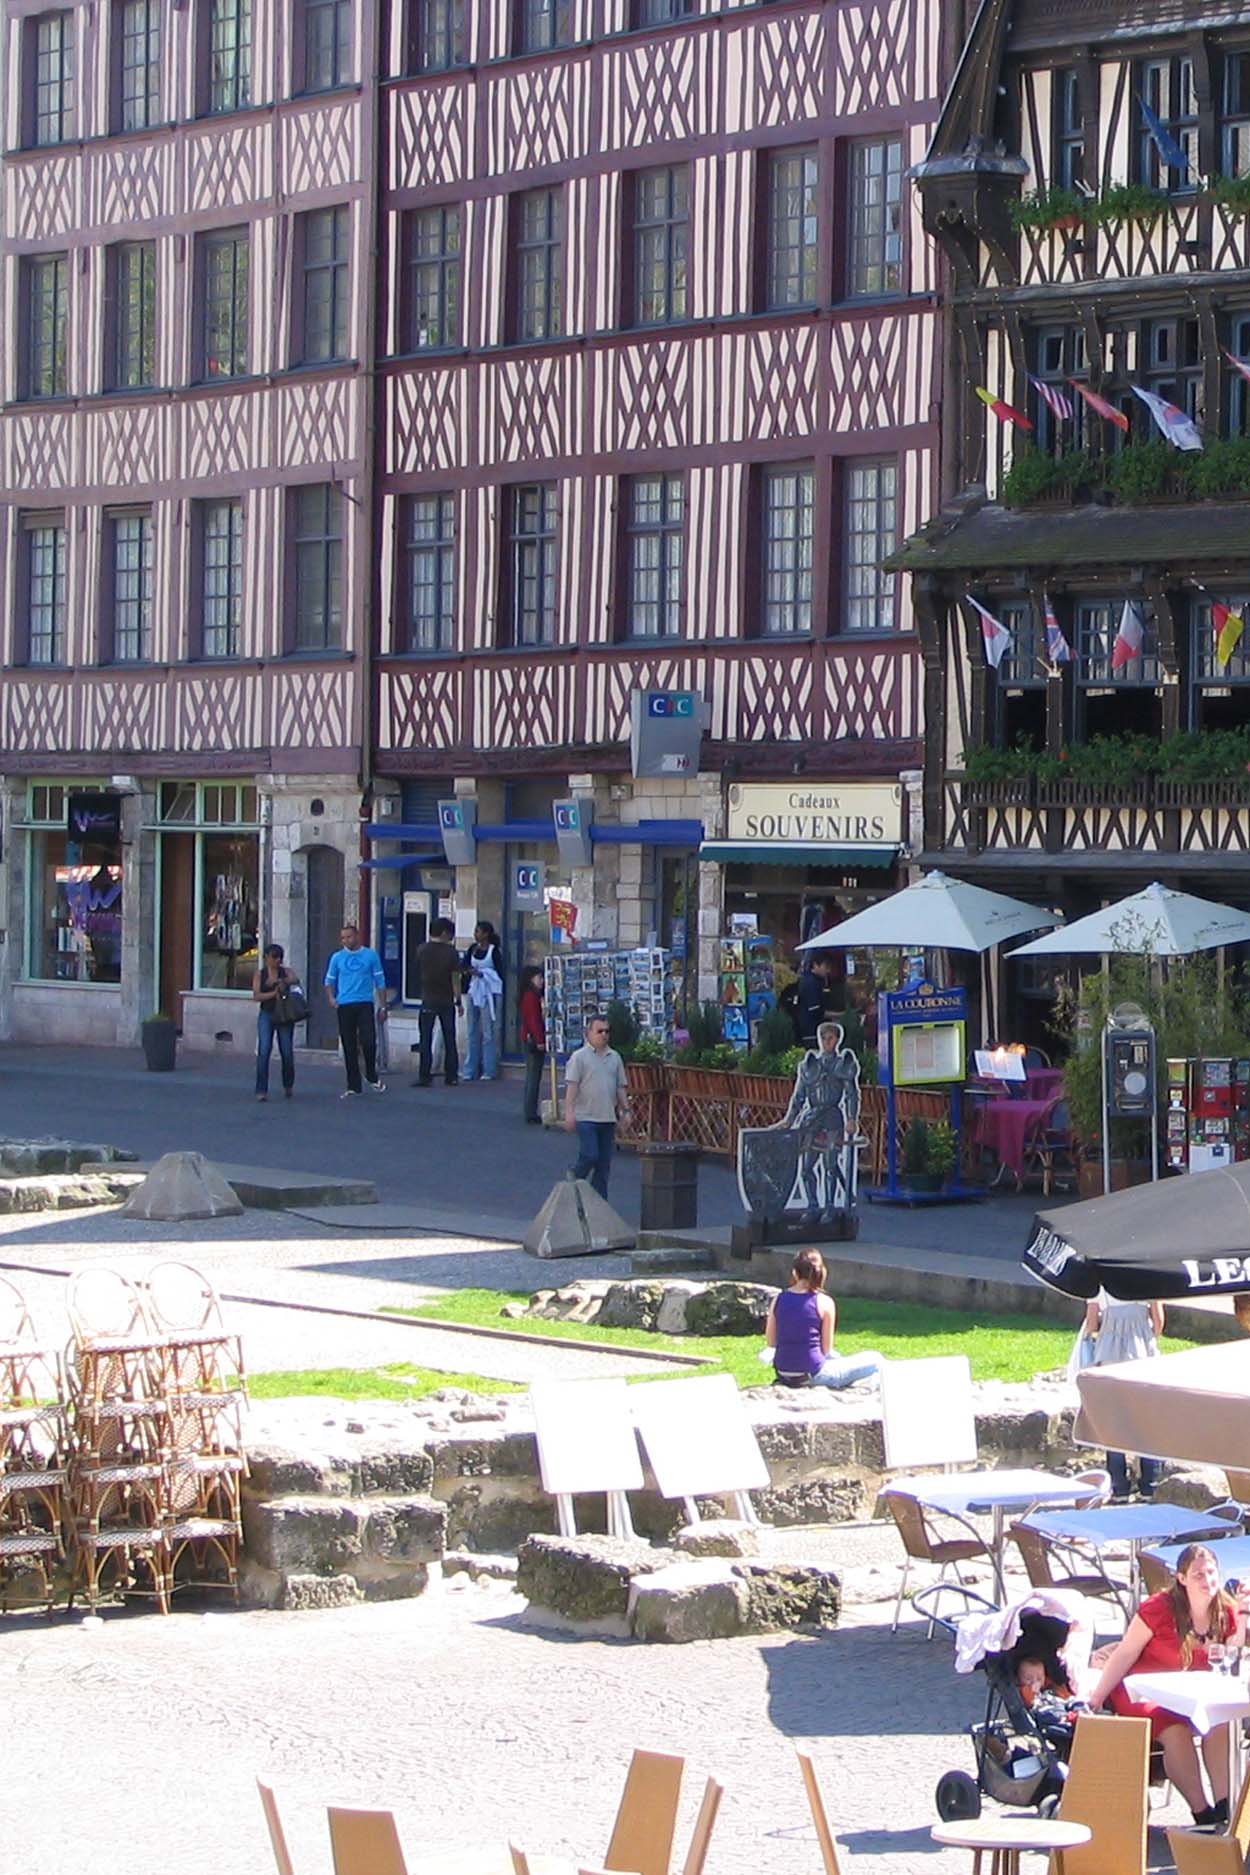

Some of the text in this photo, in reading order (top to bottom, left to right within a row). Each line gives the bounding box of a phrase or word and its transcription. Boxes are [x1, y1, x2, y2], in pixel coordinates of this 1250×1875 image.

[789, 793, 840, 809] Cadeaux
[443, 810, 463, 825] CC
[558, 809, 577, 825] CC
[746, 815, 884, 840] SOUVENIRS
[519, 870, 537, 886] CC
